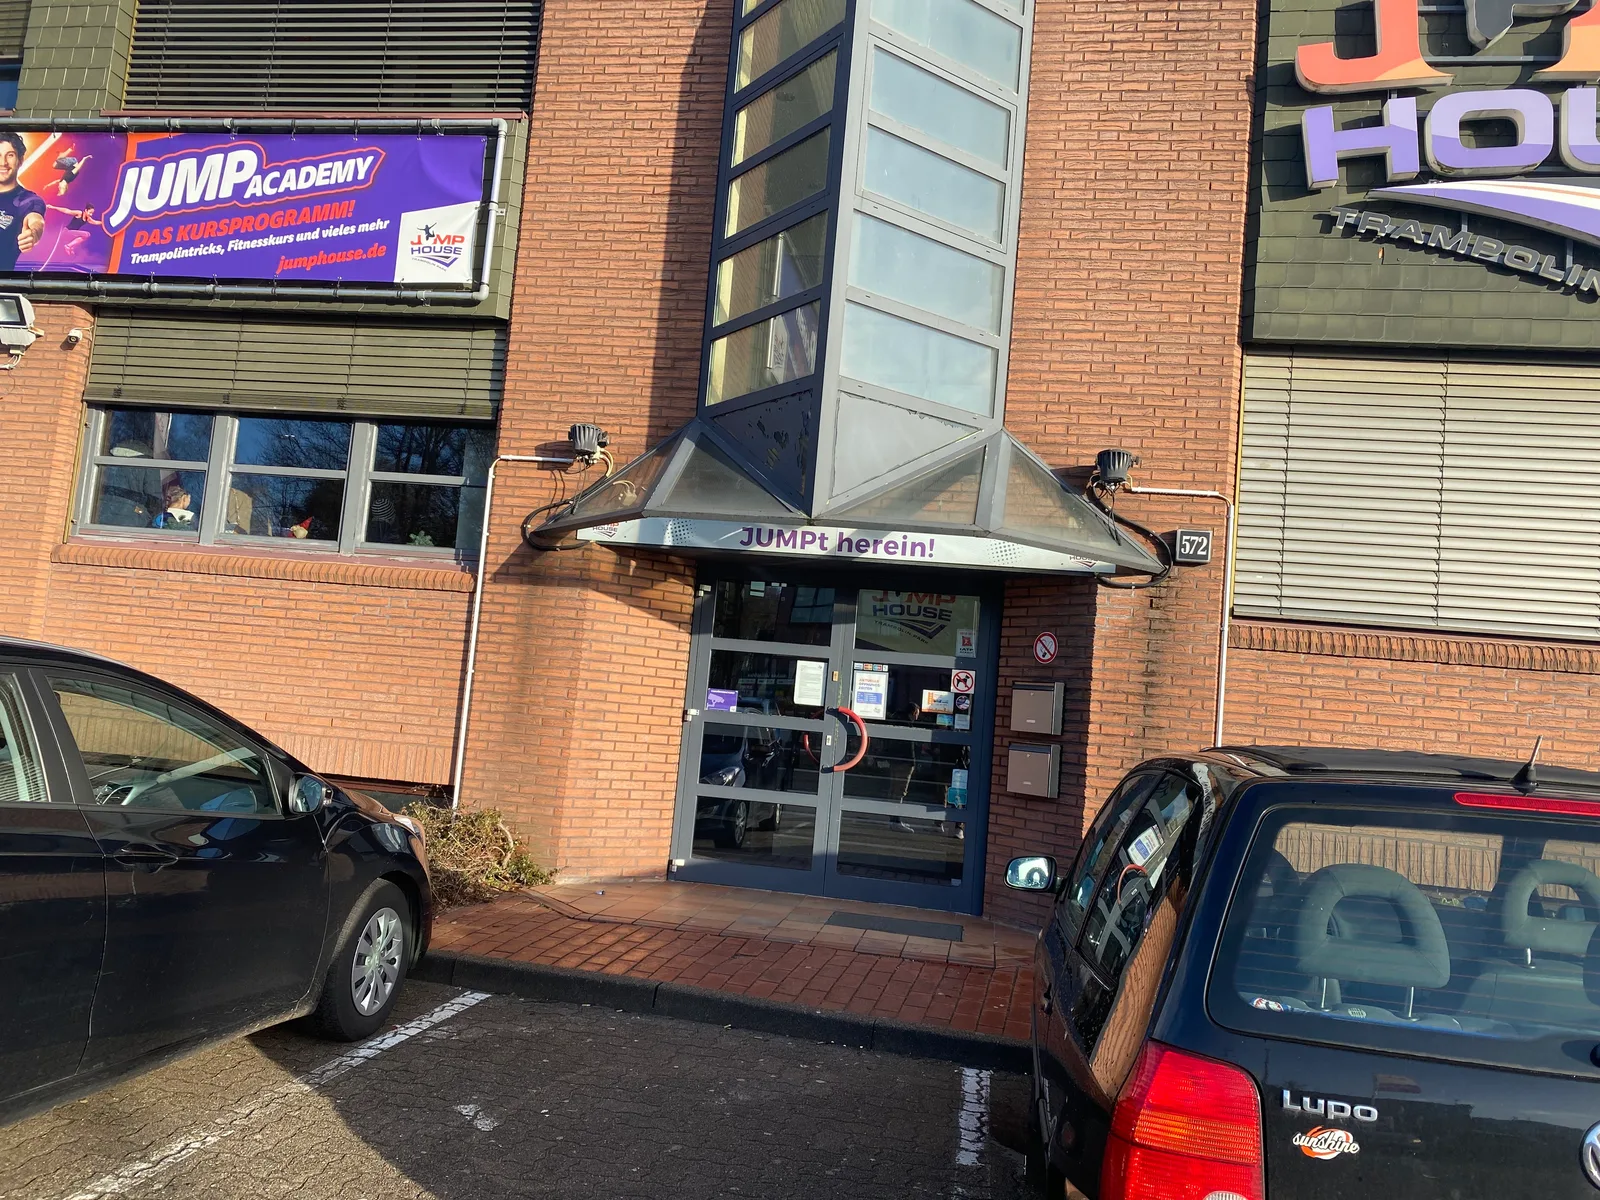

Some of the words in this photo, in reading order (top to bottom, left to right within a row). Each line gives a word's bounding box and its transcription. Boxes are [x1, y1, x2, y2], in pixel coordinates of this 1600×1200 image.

[109, 149, 258, 228] JUMP
[243, 155, 375, 199] ACADEMY
[133, 226, 174, 248] DAS
[176, 199, 356, 242] KURSPROGRAMM!
[131, 243, 225, 265] Trampolintricks,
[227, 234, 295, 252] Fitnesskurs
[296, 228, 320, 242] und
[322, 223, 356, 239] vieles
[358, 218, 390, 233] mehr
[411, 245, 463, 256] HOUSE
[276, 242, 387, 275] jumphouse.de
[739, 526, 829, 551] JUMPt
[837, 532, 935, 559] herein!
[1180, 535, 1207, 556] 572
[872, 604, 953, 622] HOUSE
[1292, 1130, 1360, 1154] sunshine
